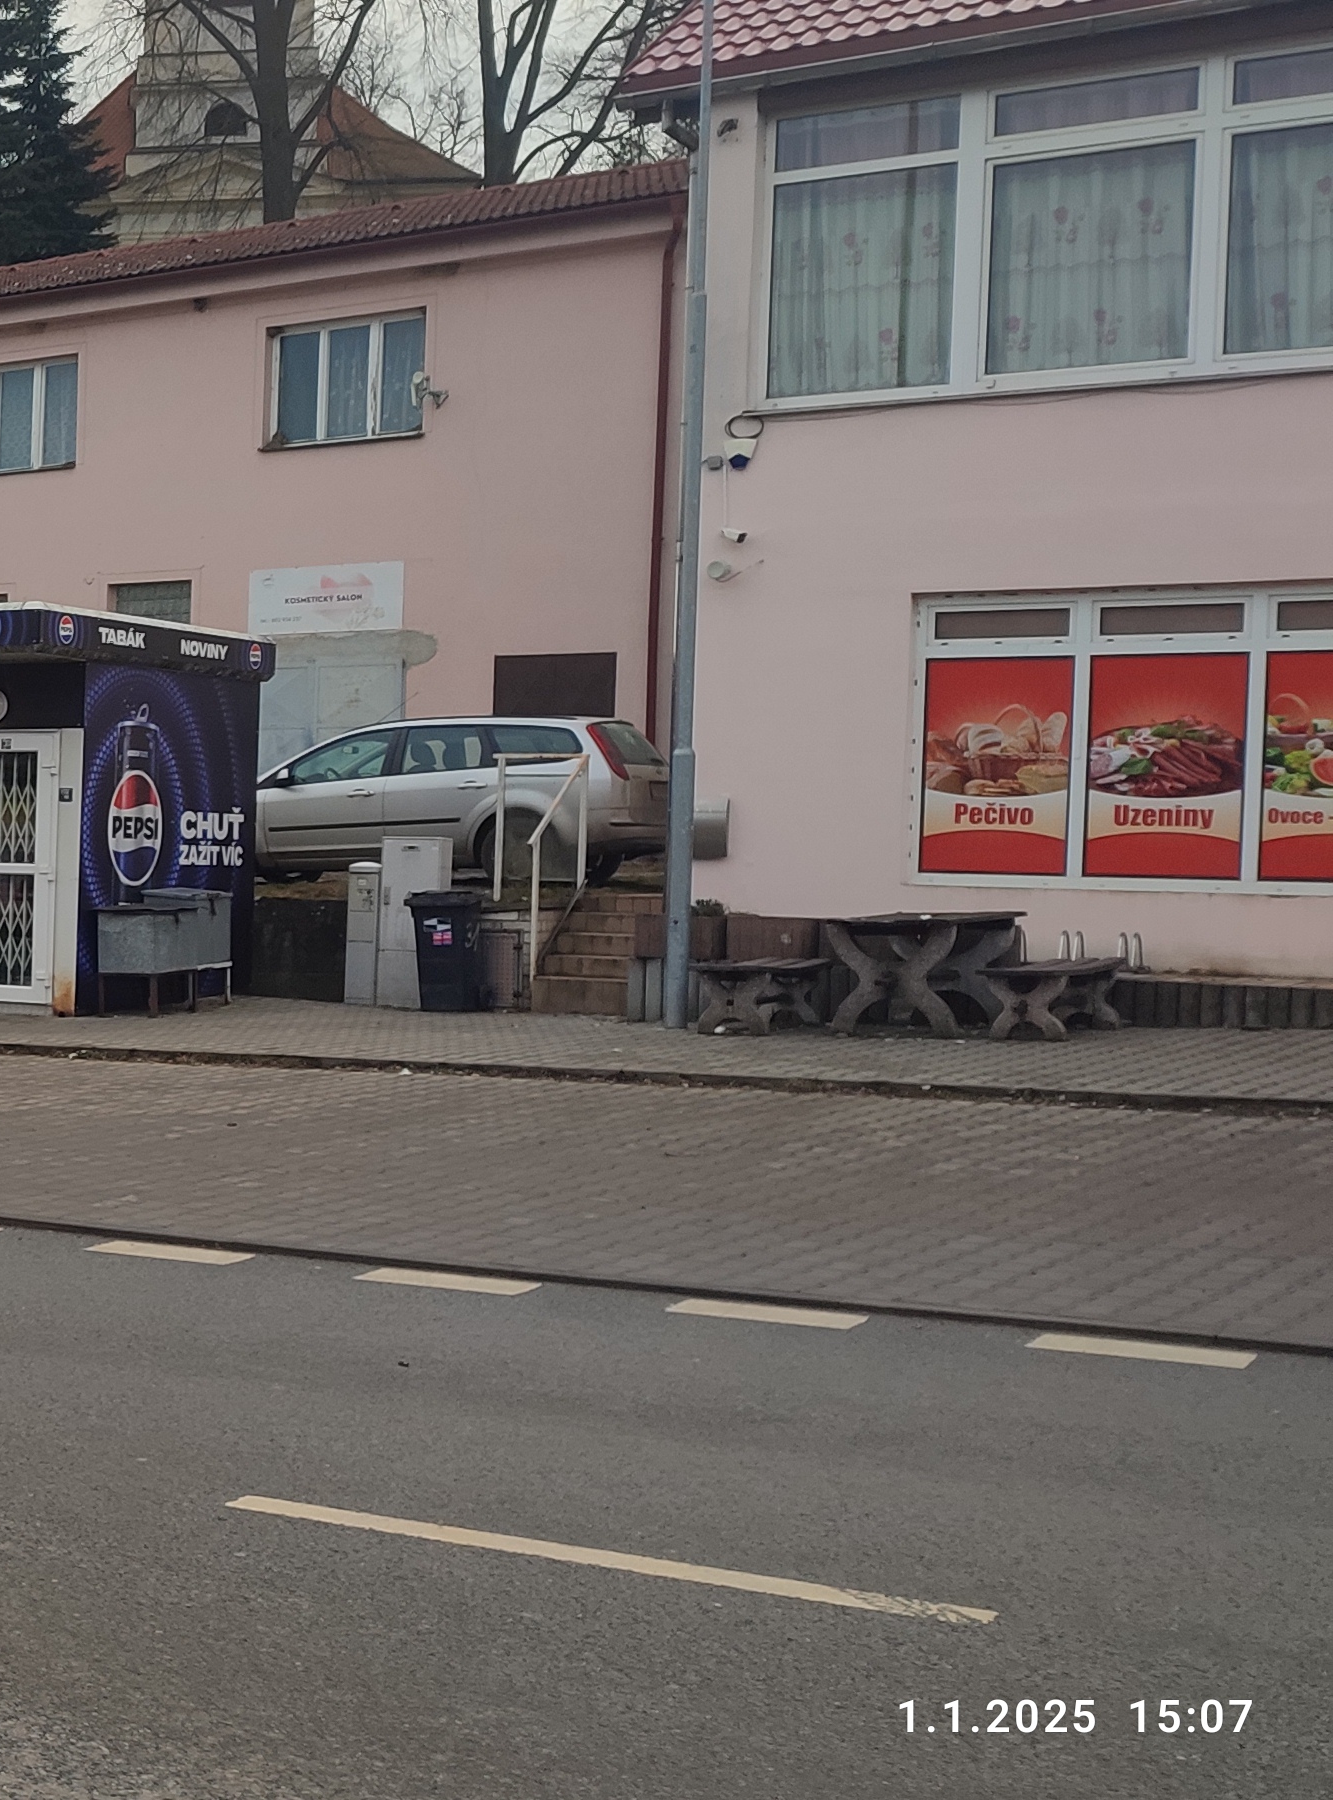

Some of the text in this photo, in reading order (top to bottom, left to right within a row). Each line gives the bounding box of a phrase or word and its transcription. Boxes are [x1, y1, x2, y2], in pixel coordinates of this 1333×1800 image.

[337, 593, 362, 602] SALON
[98, 627, 228, 661] TABÁK NOVINY
[180, 806, 245, 840] CHUŤ
[954, 801, 1034, 826] Pečivo
[1113, 804, 1215, 830] Uzeniny
[1268, 808, 1324, 825] Ovoce
[112, 815, 159, 840] PEPSI
[179, 841, 244, 867] ZAŽÍT VÍC
